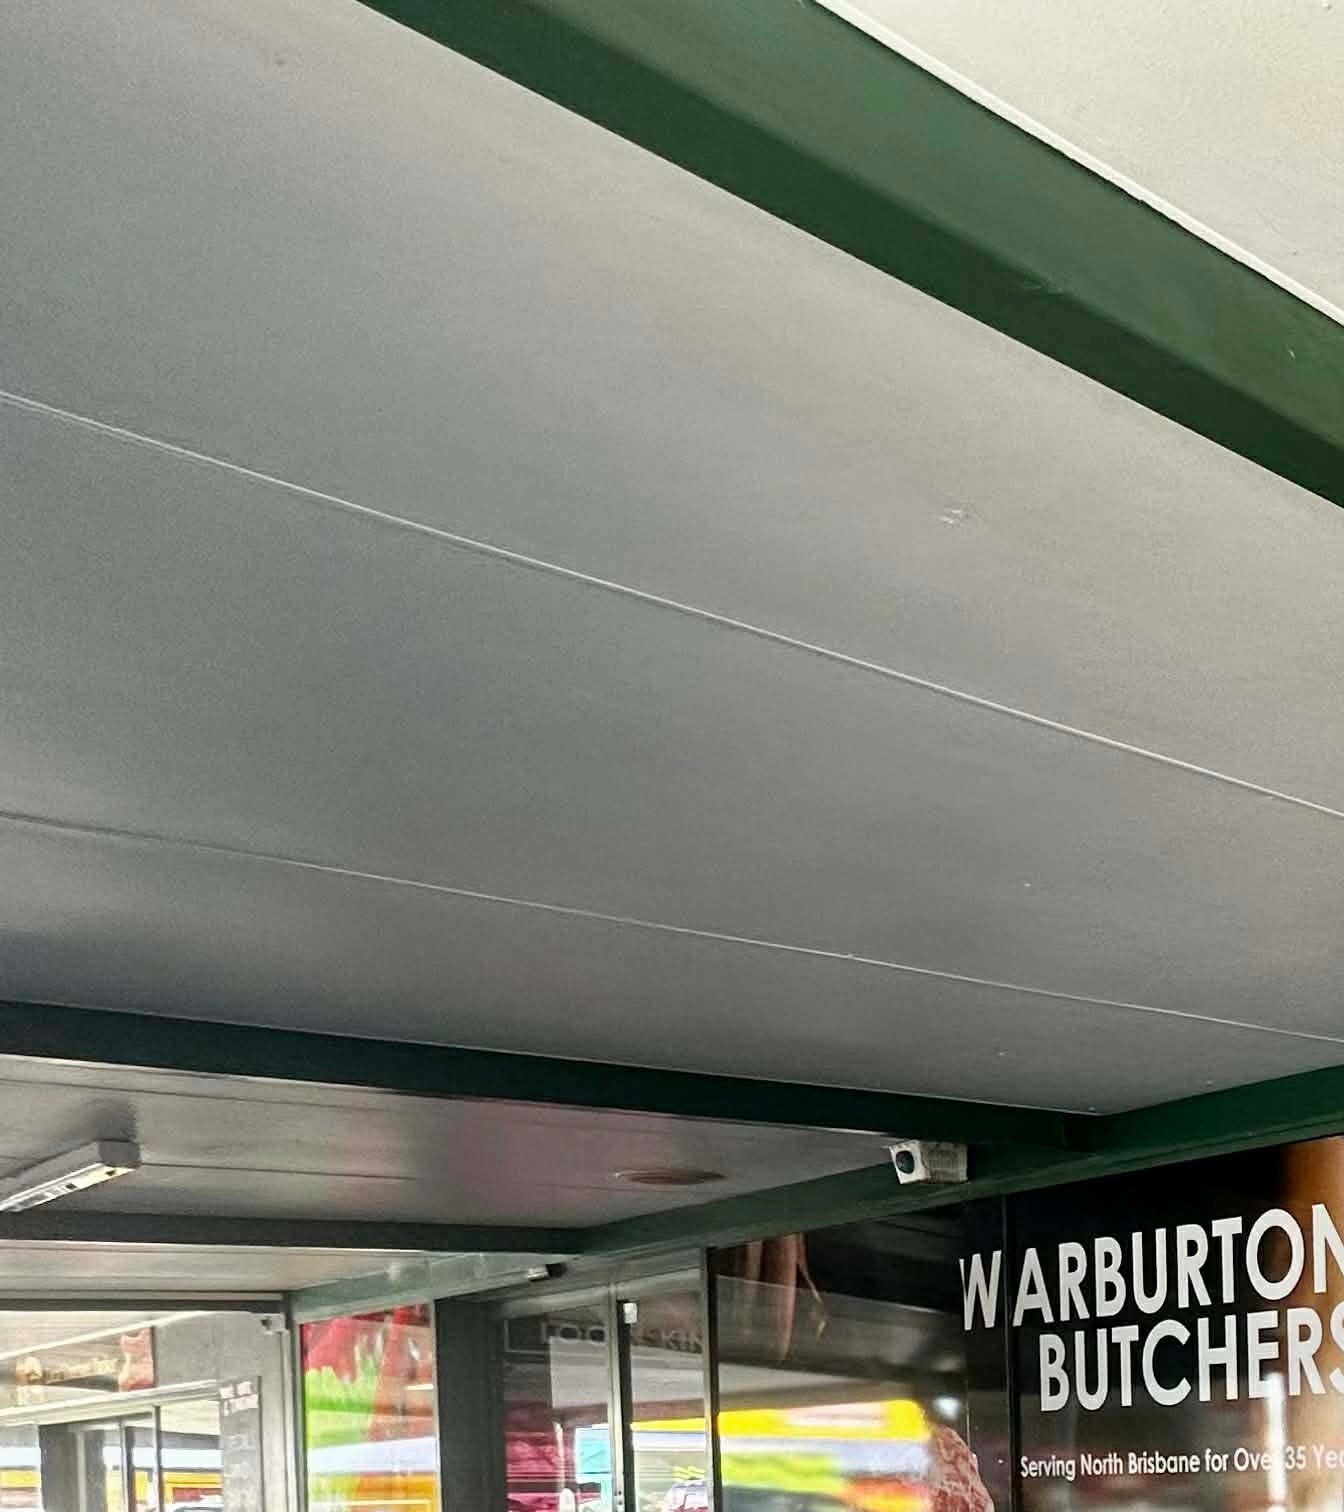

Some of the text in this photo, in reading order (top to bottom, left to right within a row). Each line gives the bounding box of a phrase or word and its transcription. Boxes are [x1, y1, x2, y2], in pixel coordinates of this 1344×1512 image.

[1020, 1455, 1076, 1481] Serving
[1080, 1452, 1124, 1475] North
[1127, 1451, 1201, 1474] Brisbane
[1204, 1448, 1229, 1472] for
[1234, 1447, 1279, 1472] Ove
[1285, 1446, 1307, 1470] 35
